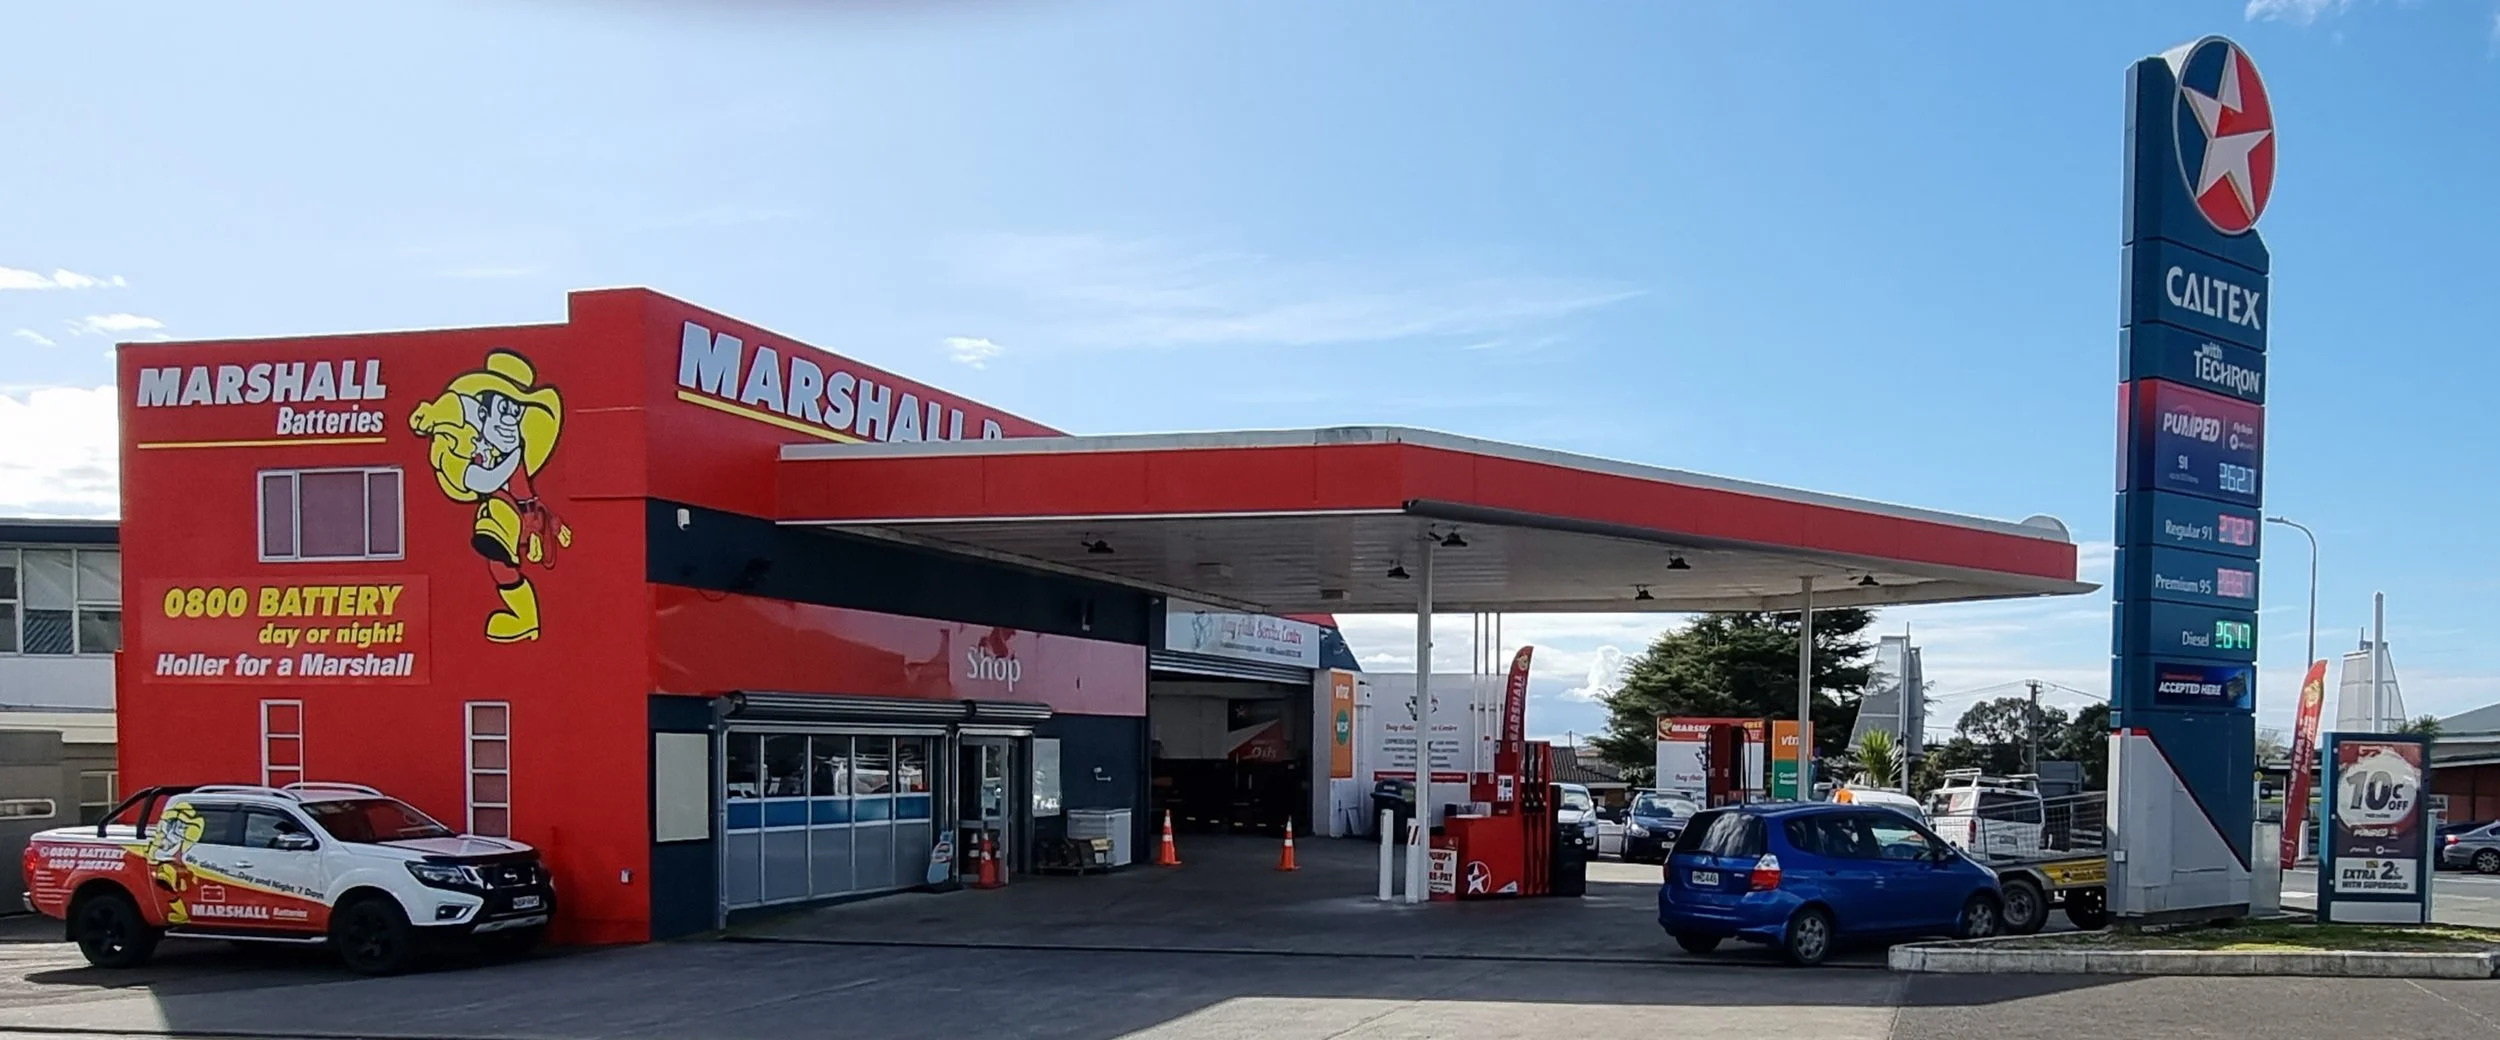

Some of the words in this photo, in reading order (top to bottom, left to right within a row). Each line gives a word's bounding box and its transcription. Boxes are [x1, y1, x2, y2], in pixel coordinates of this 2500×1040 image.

[2166, 266, 2260, 330] CALTEX
[2202, 341, 2223, 360] with
[137, 359, 387, 408] MARSHALL
[2193, 350, 2261, 395] TECHRON
[276, 406, 384, 437] Batteries
[2162, 411, 2220, 443] PUMPED
[2165, 519, 2200, 541] Regular
[2201, 525, 2213, 541] 91
[2155, 573, 2199, 594] Premium
[2199, 579, 2212, 594] 95
[163, 586, 249, 620] 0800
[257, 584, 403, 618] BATTERY
[258, 623, 300, 649] day
[306, 629, 333, 645] or
[336, 621, 405, 650] night!
[2182, 630, 2210, 648] Diesel
[156, 653, 231, 678] Holler
[234, 653, 273, 677] for
[276, 658, 294, 677] a
[300, 652, 414, 679] Marshall
[966, 645, 1021, 693] Shop
[2158, 681, 2200, 695] ACCEPTED
[2201, 683, 2222, 696] HERE
[2388, 800, 2409, 811] OFF
[79, 847, 128, 859] BATTERY
[2342, 868, 2376, 880] EXTRA
[2342, 881, 2362, 889] WITH
[192, 903, 270, 919] MARSHALL
